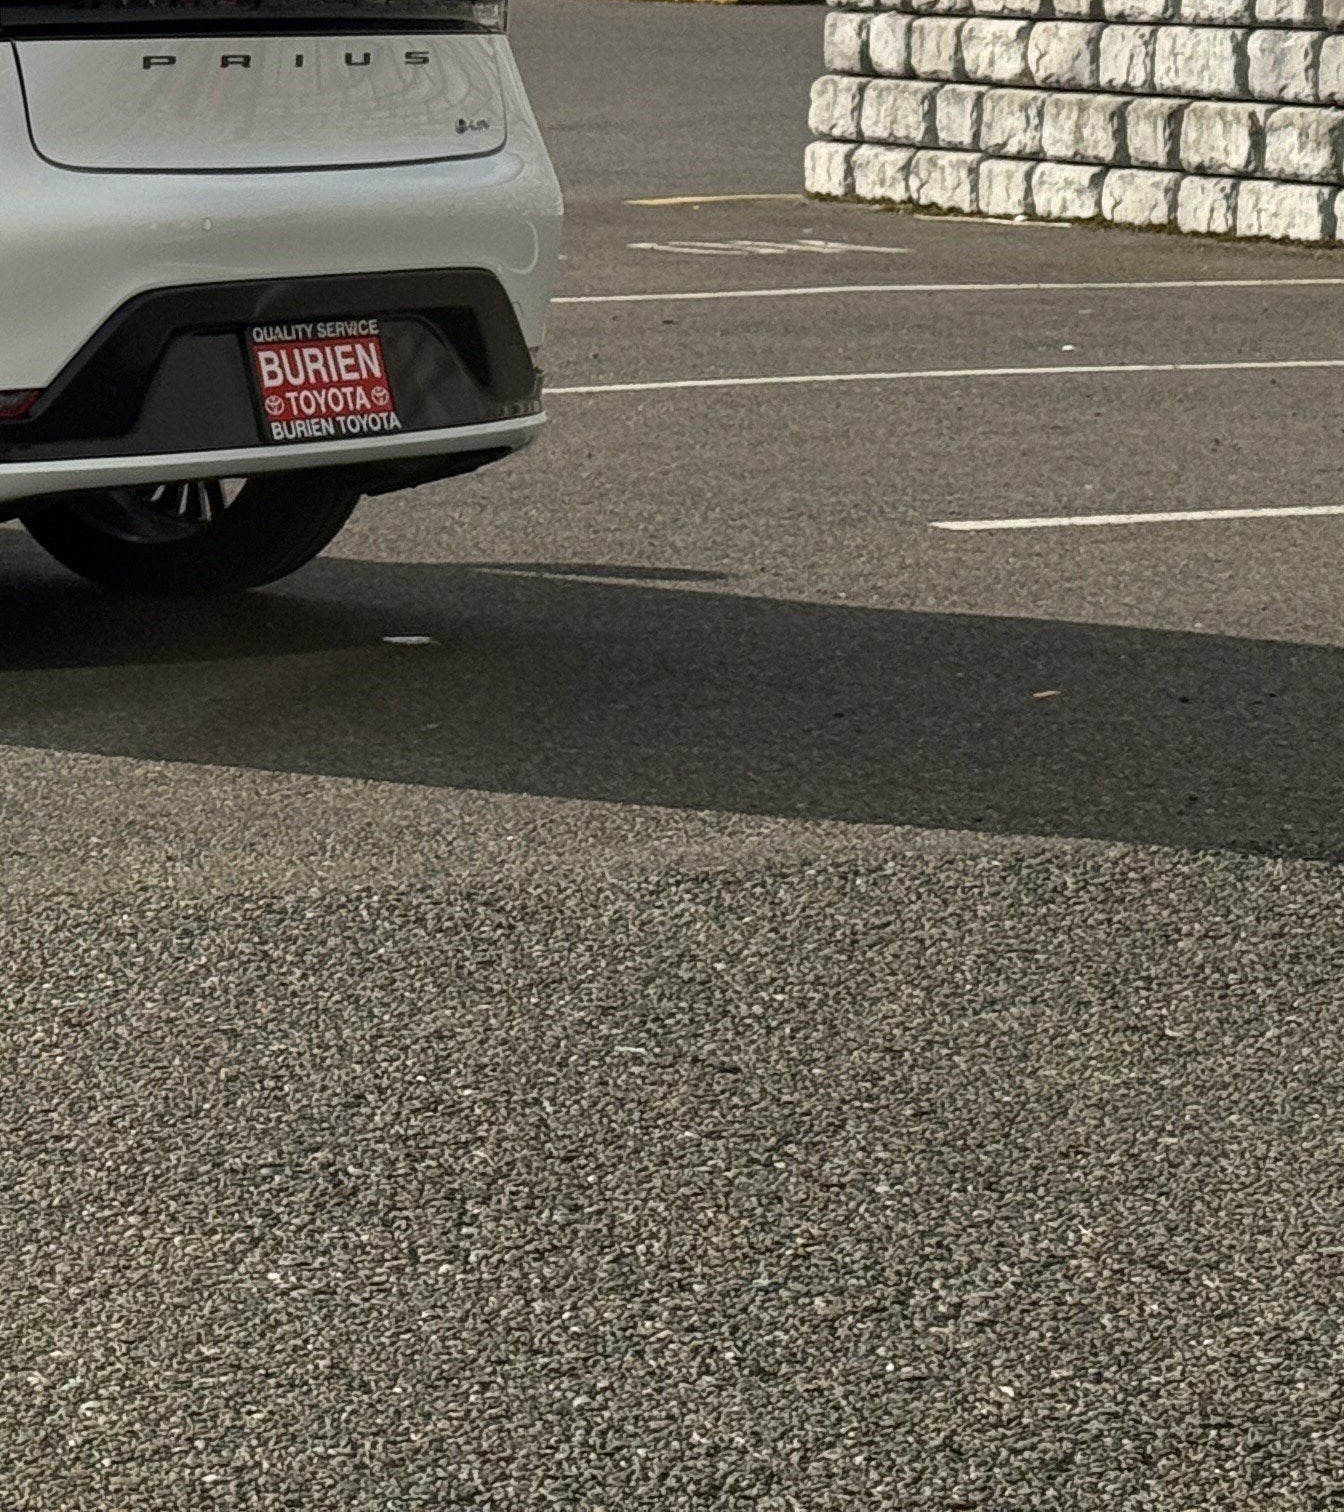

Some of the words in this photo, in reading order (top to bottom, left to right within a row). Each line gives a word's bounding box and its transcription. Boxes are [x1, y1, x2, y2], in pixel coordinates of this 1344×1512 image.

[142, 50, 430, 70] PRIUS
[252, 323, 314, 343] QUALITY
[316, 318, 380, 338] SERVICE
[257, 342, 382, 388] BURIEN
[285, 386, 372, 416] TOYOTA
[270, 417, 336, 440] BURIEN
[336, 411, 402, 434] TOYOTA
